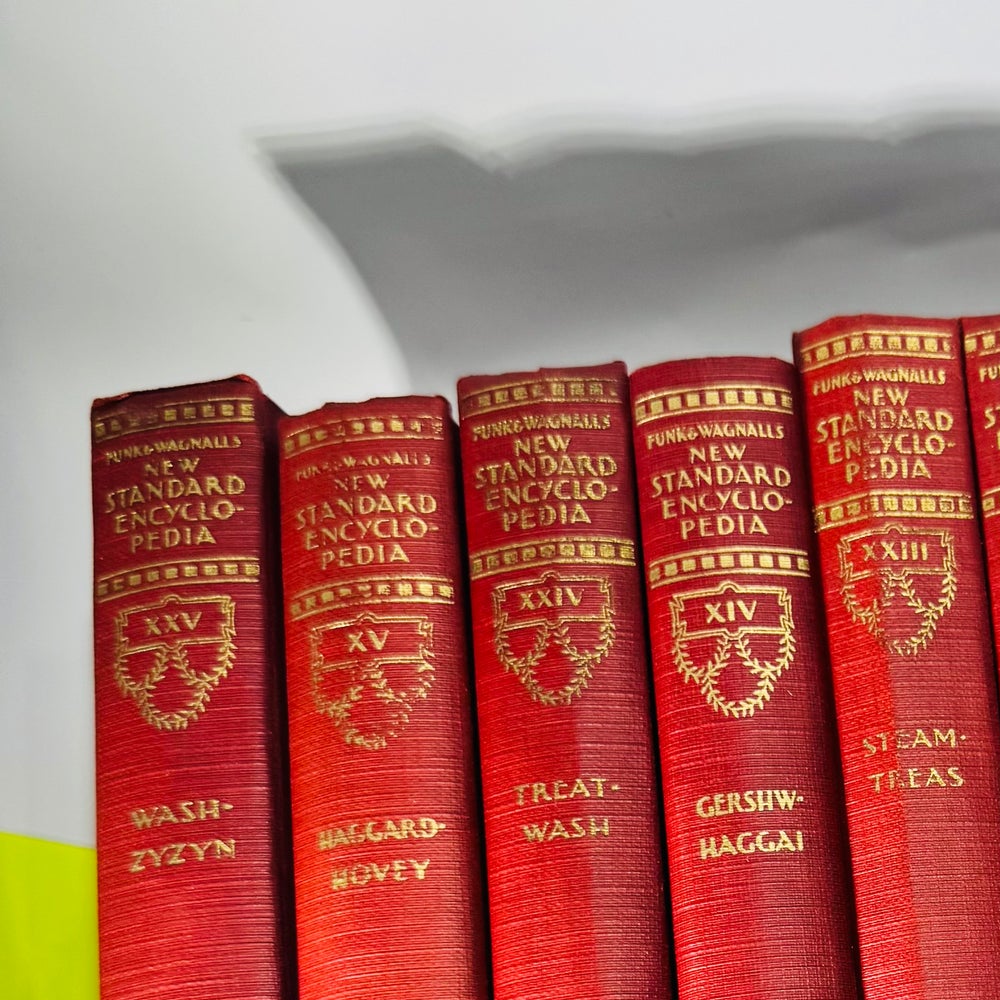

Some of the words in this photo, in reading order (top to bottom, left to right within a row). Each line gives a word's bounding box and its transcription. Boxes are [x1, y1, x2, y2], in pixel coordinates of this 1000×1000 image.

[853, 387, 910, 407] NEW
[815, 408, 954, 444] STANDARD
[514, 433, 572, 456] NEW
[689, 443, 747, 465] NEW
[827, 432, 957, 465] ENCYCLO-
[144, 457, 200, 476] NEW
[475, 454, 619, 489] STANDARD
[845, 457, 931, 484] PEDIA
[105, 475, 246, 514] STANDARD
[334, 473, 390, 491] NEW
[484, 479, 619, 511] ENCYCLO-
[652, 464, 792, 499] STANDARD
[115, 500, 244, 534] ENCYCLO-
[296, 494, 437, 530] STANDARD
[502, 504, 591, 531] PEDIA
[661, 489, 793, 520] ENCYCLO-
[131, 526, 217, 554] PEDIA
[305, 517, 439, 550] ENCYCLO-
[681, 514, 769, 540] PEDIA
[321, 545, 410, 570] PEDIA
[861, 540, 929, 562] XXIII
[520, 587, 584, 610] XXIV
[705, 599, 758, 624] XIV
[144, 611, 202, 635] XXV
[347, 629, 390, 653] XV
[862, 728, 966, 758] STEAM-
[513, 778, 620, 806] TREAT-
[868, 767, 965, 794] TREAS
[130, 799, 234, 830] WASH-
[695, 789, 804, 818] GERSHW-
[522, 817, 610, 843] WASH
[129, 838, 236, 873] ZYZYN
[699, 830, 804, 860] HAGGAI
[330, 858, 431, 890] HOVEY
